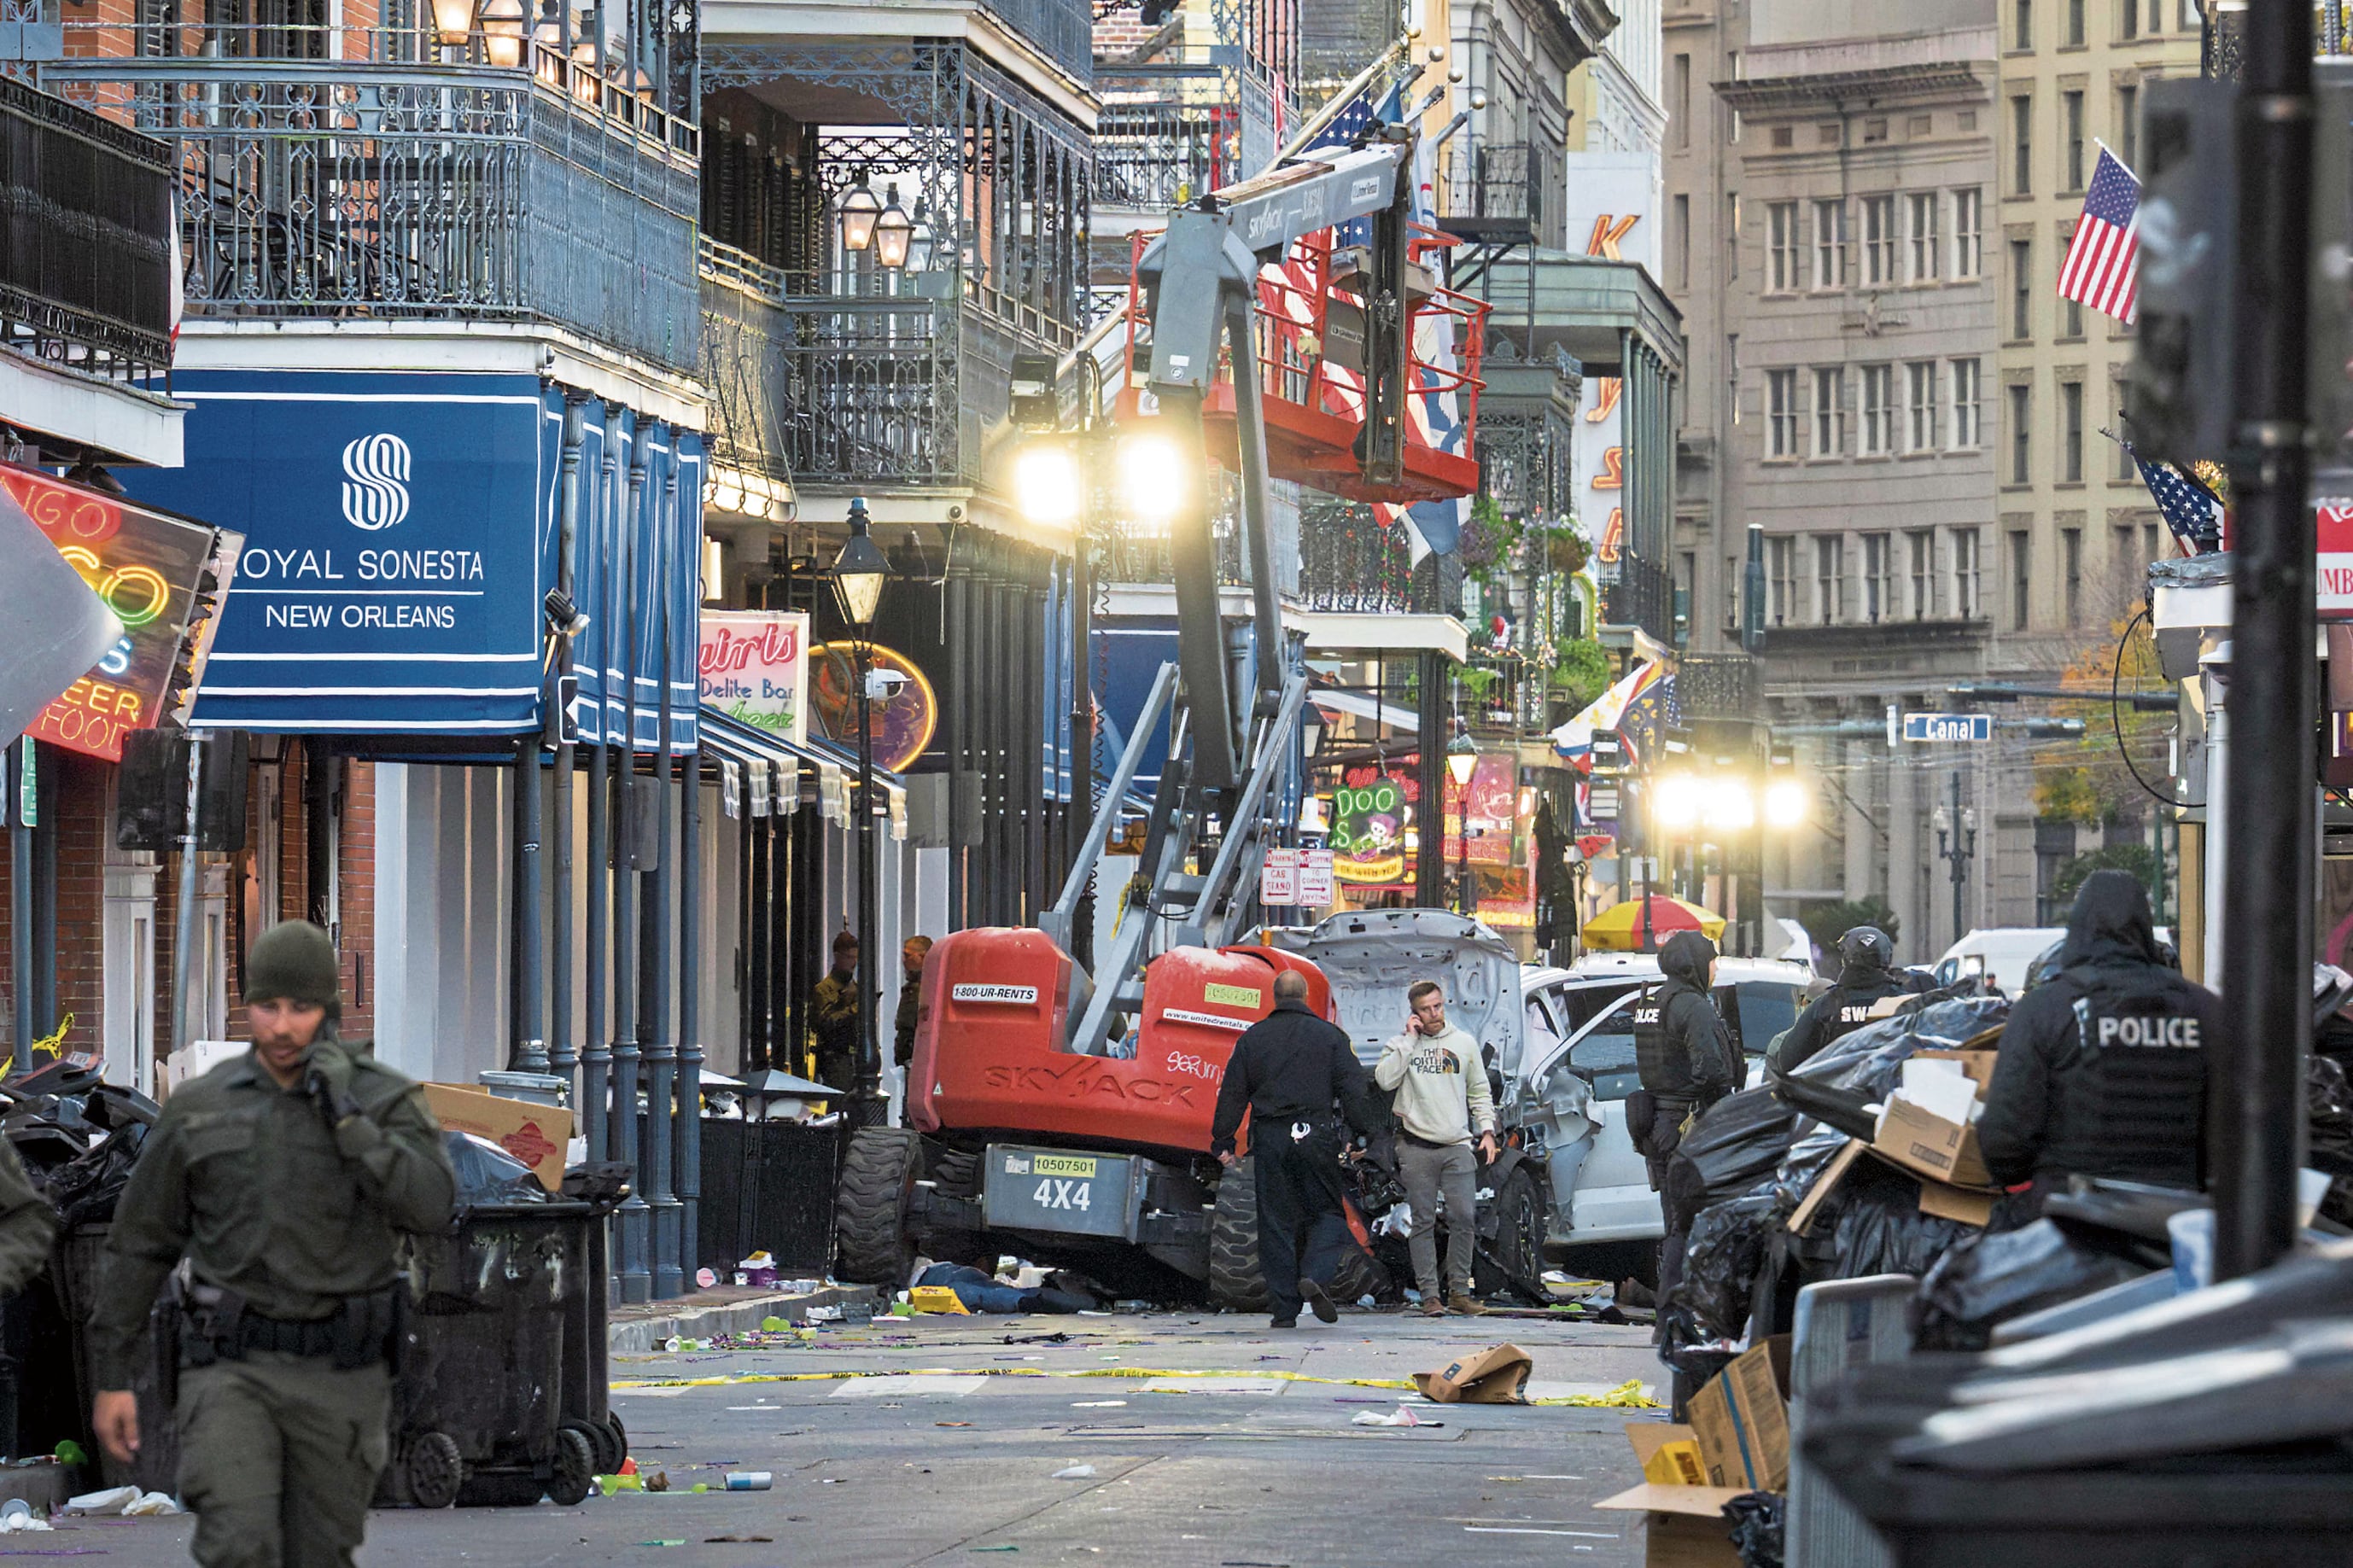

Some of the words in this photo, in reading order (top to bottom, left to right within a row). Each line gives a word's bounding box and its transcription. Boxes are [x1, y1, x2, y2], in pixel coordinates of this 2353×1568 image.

[232, 548, 344, 580] OYAL
[357, 549, 484, 581] SONESTA
[266, 604, 333, 629] NEW
[342, 604, 455, 630] ORLEANS
[701, 677, 753, 698] Delite
[762, 679, 794, 699] Bar
[1926, 717, 1975, 738] Canal
[1271, 870, 1286, 878] CAB
[1266, 882, 1291, 890] STAND
[955, 986, 1034, 1000] 1-800-UR-RENTS
[1841, 1006, 1871, 1022] SW
[2098, 1017, 2201, 1047] POLICE
[1423, 1048, 1443, 1057] THE
[1416, 1065, 1442, 1074] FACE
[984, 1059, 1194, 1109] SKYJACK
[1036, 1159, 1095, 1172] 10507501
[1033, 1179, 1091, 1211] 4X4
